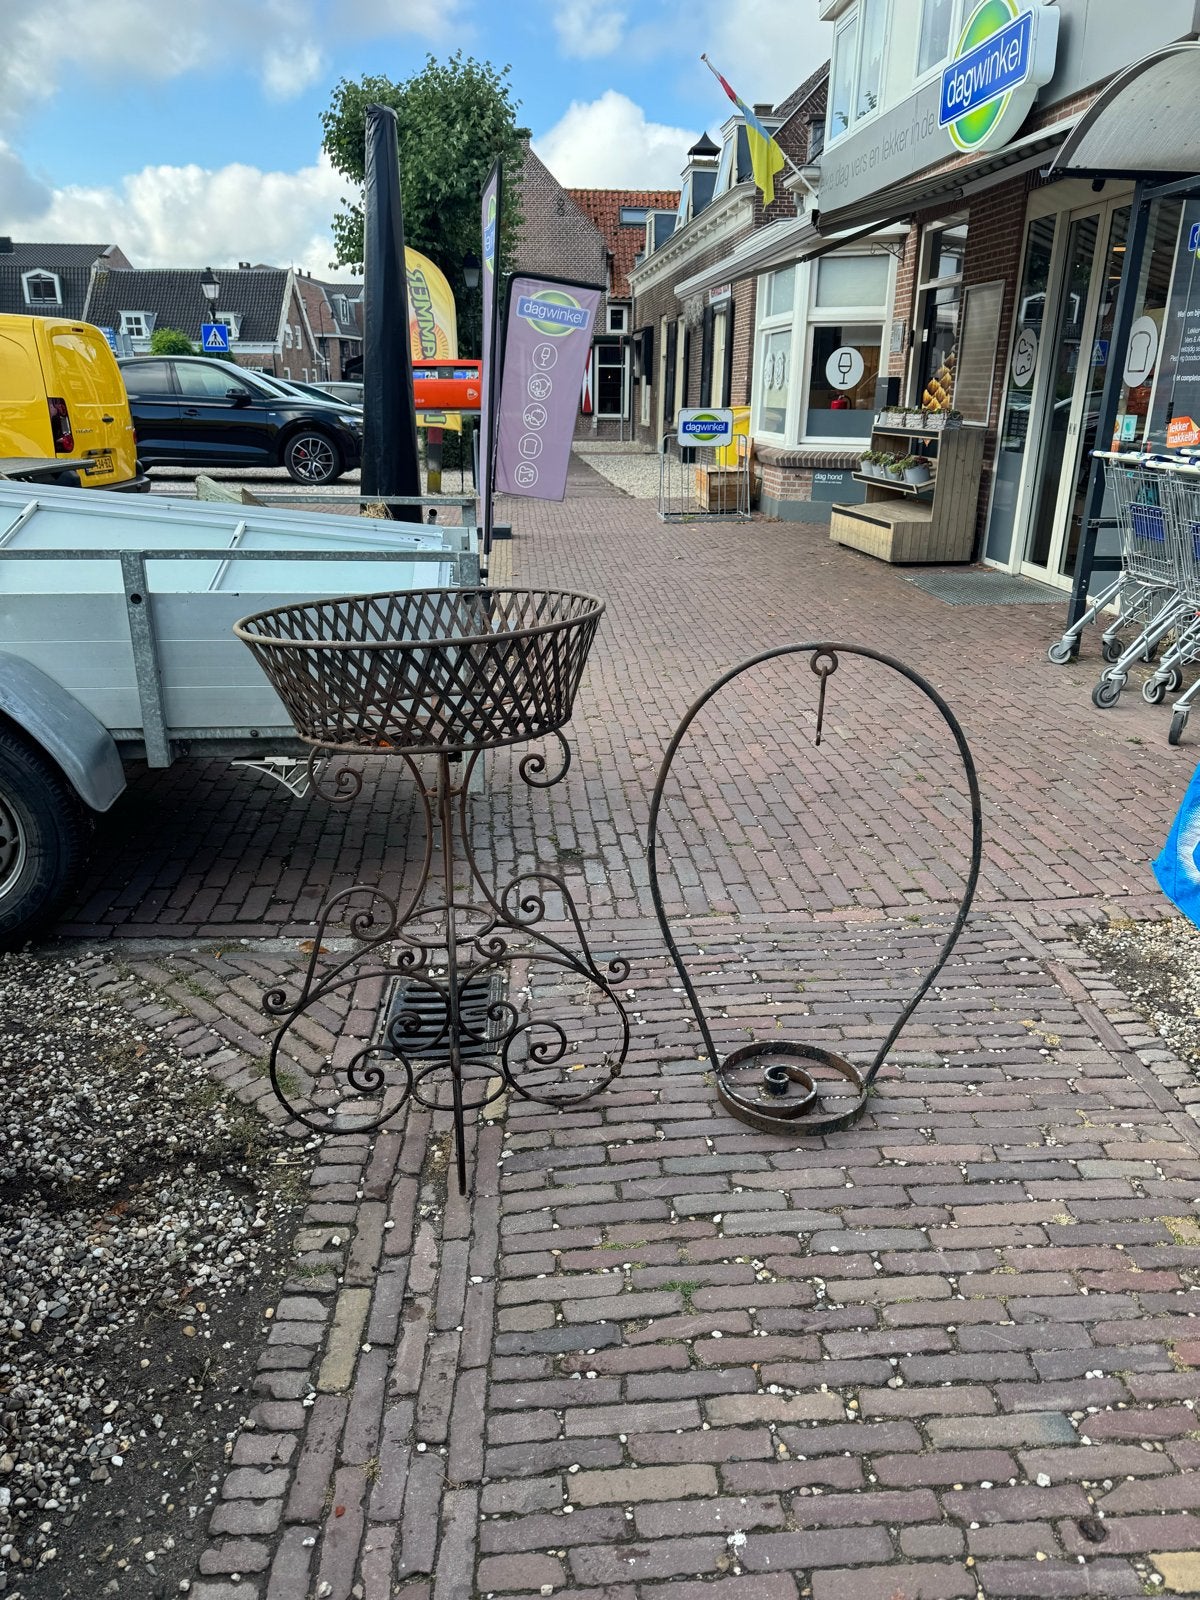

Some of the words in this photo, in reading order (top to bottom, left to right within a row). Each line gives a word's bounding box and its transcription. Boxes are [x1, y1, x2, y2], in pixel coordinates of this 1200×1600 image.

[946, 23, 1025, 108] dagwinkel
[836, 162, 849, 188] dag
[851, 153, 868, 178] vers
[869, 145, 880, 168] en
[881, 127, 909, 162] lekker
[921, 108, 935, 140] de
[523, 300, 585, 324] dagwinkel
[685, 422, 726, 433] dagwinkel
[815, 472, 826, 481] dag
